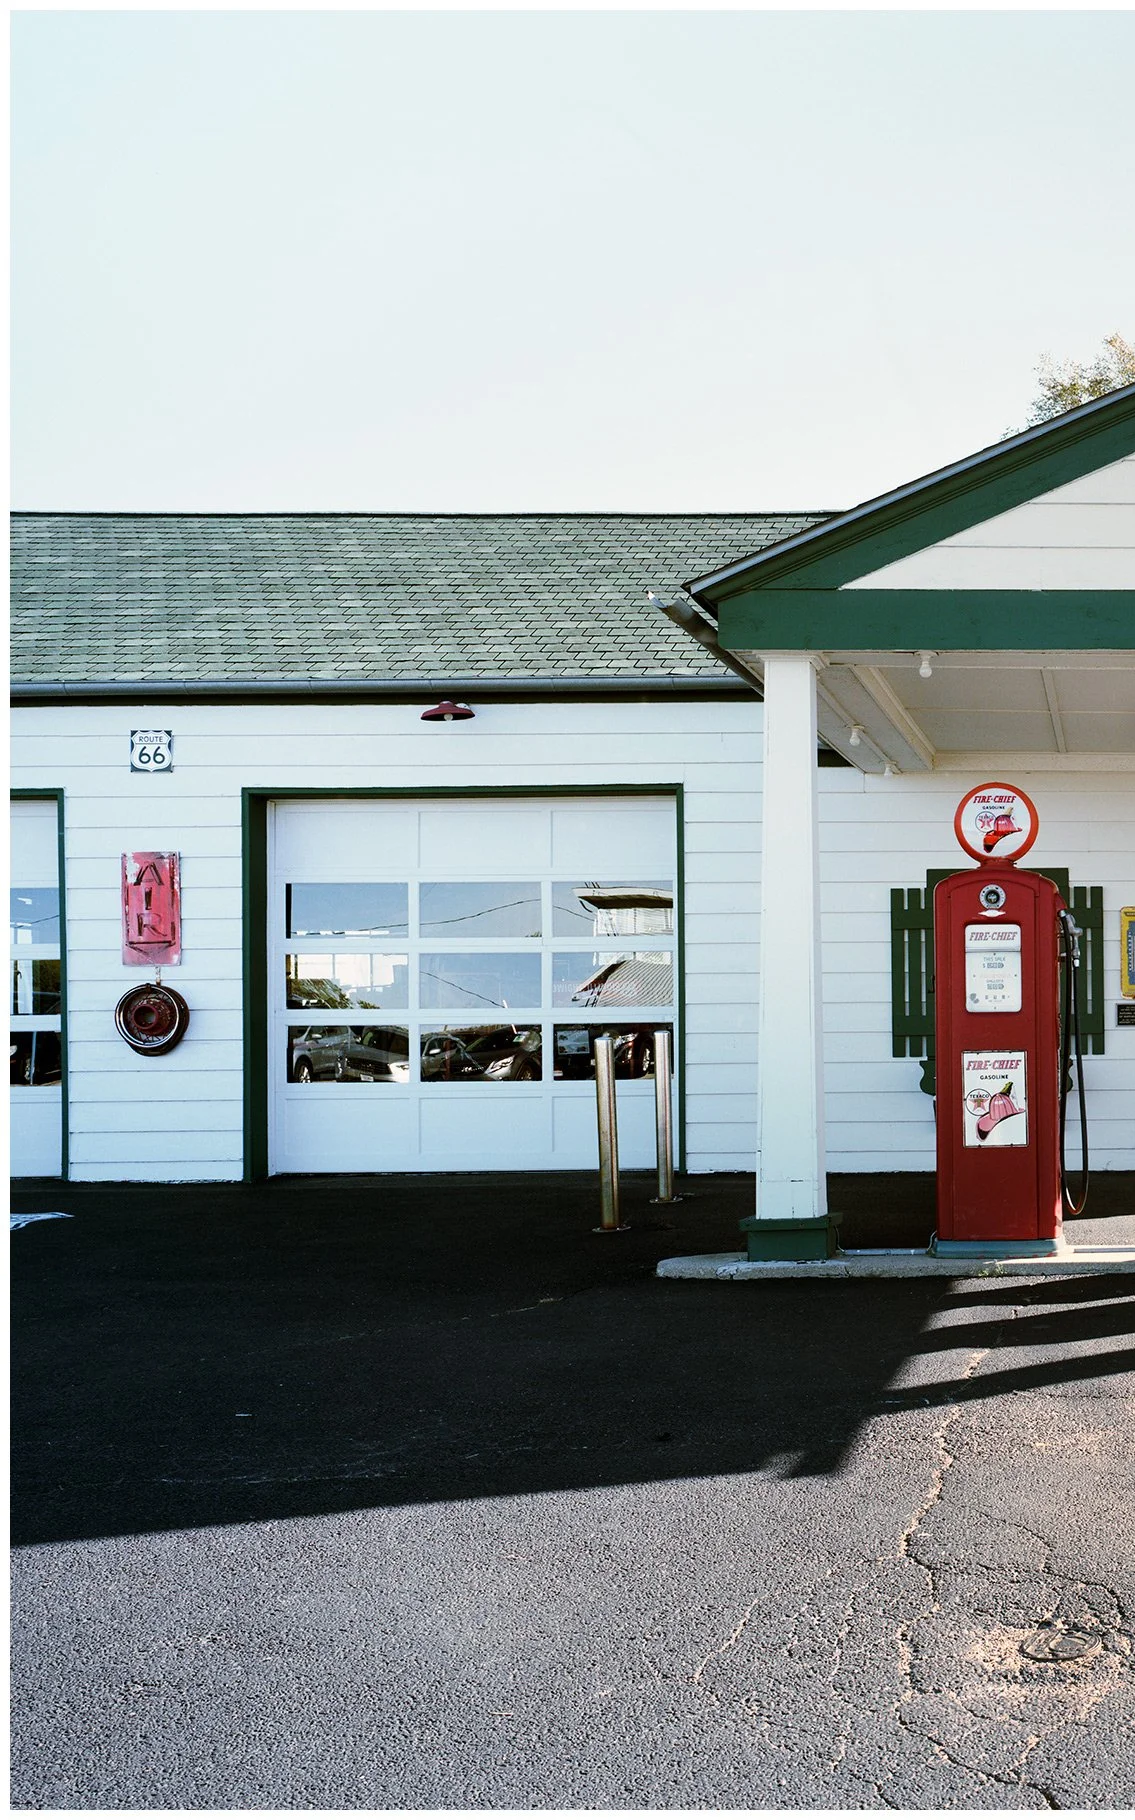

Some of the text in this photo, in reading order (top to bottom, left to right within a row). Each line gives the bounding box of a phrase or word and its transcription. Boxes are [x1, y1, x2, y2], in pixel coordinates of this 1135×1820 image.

[138, 735, 164, 743] ROUTE
[138, 746, 165, 764] 66
[973, 795, 1017, 804] FIRE-CHIEF
[133, 861, 168, 938] AIR
[969, 931, 1018, 941] FIRE-CHIEF
[966, 1060, 1022, 1071] FIRE-CHIEF
